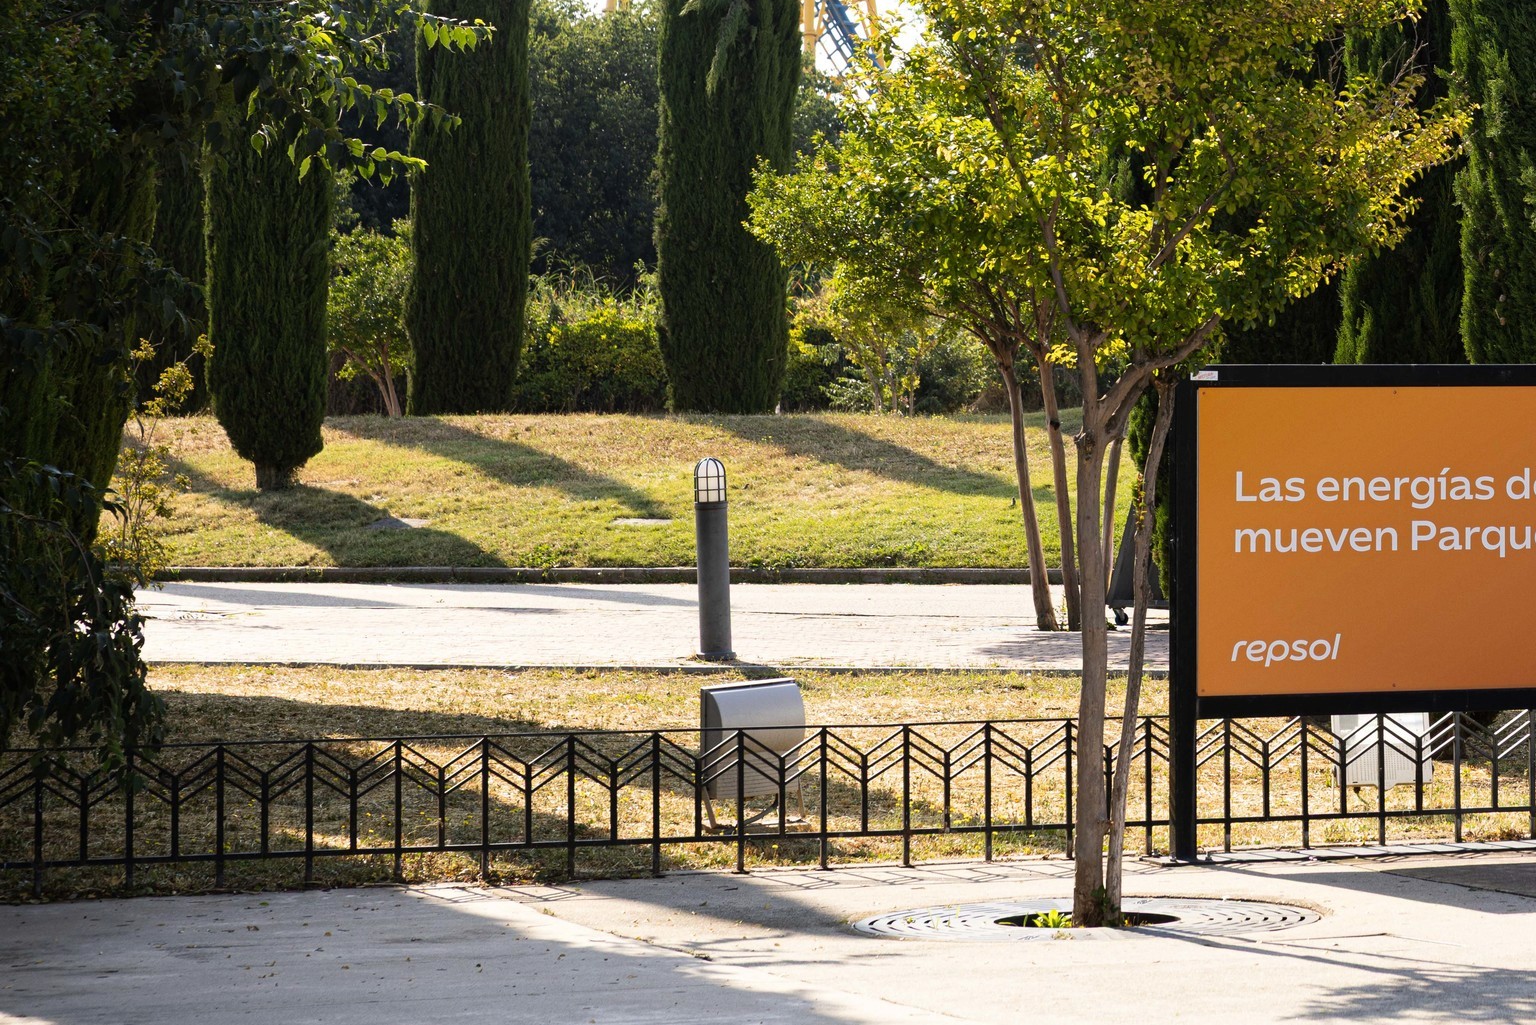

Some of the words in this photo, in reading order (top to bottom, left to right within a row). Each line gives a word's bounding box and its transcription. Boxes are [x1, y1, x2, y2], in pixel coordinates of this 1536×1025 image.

[1236, 471, 1305, 502] Las
[1317, 468, 1494, 509] energías
[1235, 528, 1397, 552] mueven
[1231, 634, 1341, 667] repsol
